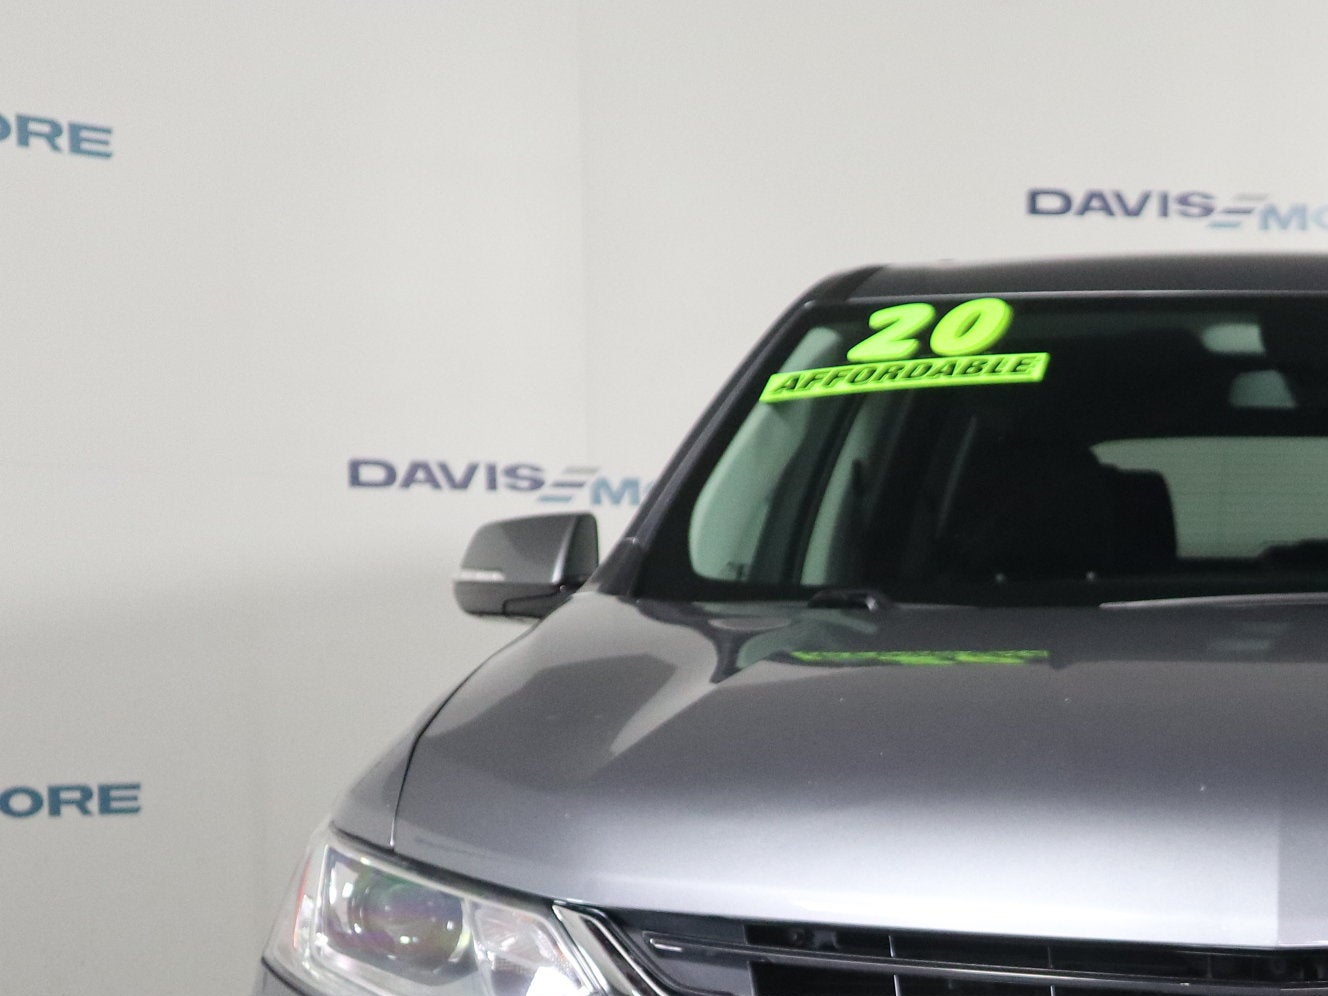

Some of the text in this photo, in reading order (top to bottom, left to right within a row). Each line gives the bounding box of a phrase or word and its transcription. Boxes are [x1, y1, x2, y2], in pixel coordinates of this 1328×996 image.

[0, 113, 113, 159] RE
[1025, 187, 1216, 219] DAVIS
[847, 298, 1013, 362] 20
[772, 355, 1037, 394] AFFORDABLE
[348, 457, 656, 506] DAVIS M
[0, 783, 141, 819] ORE
